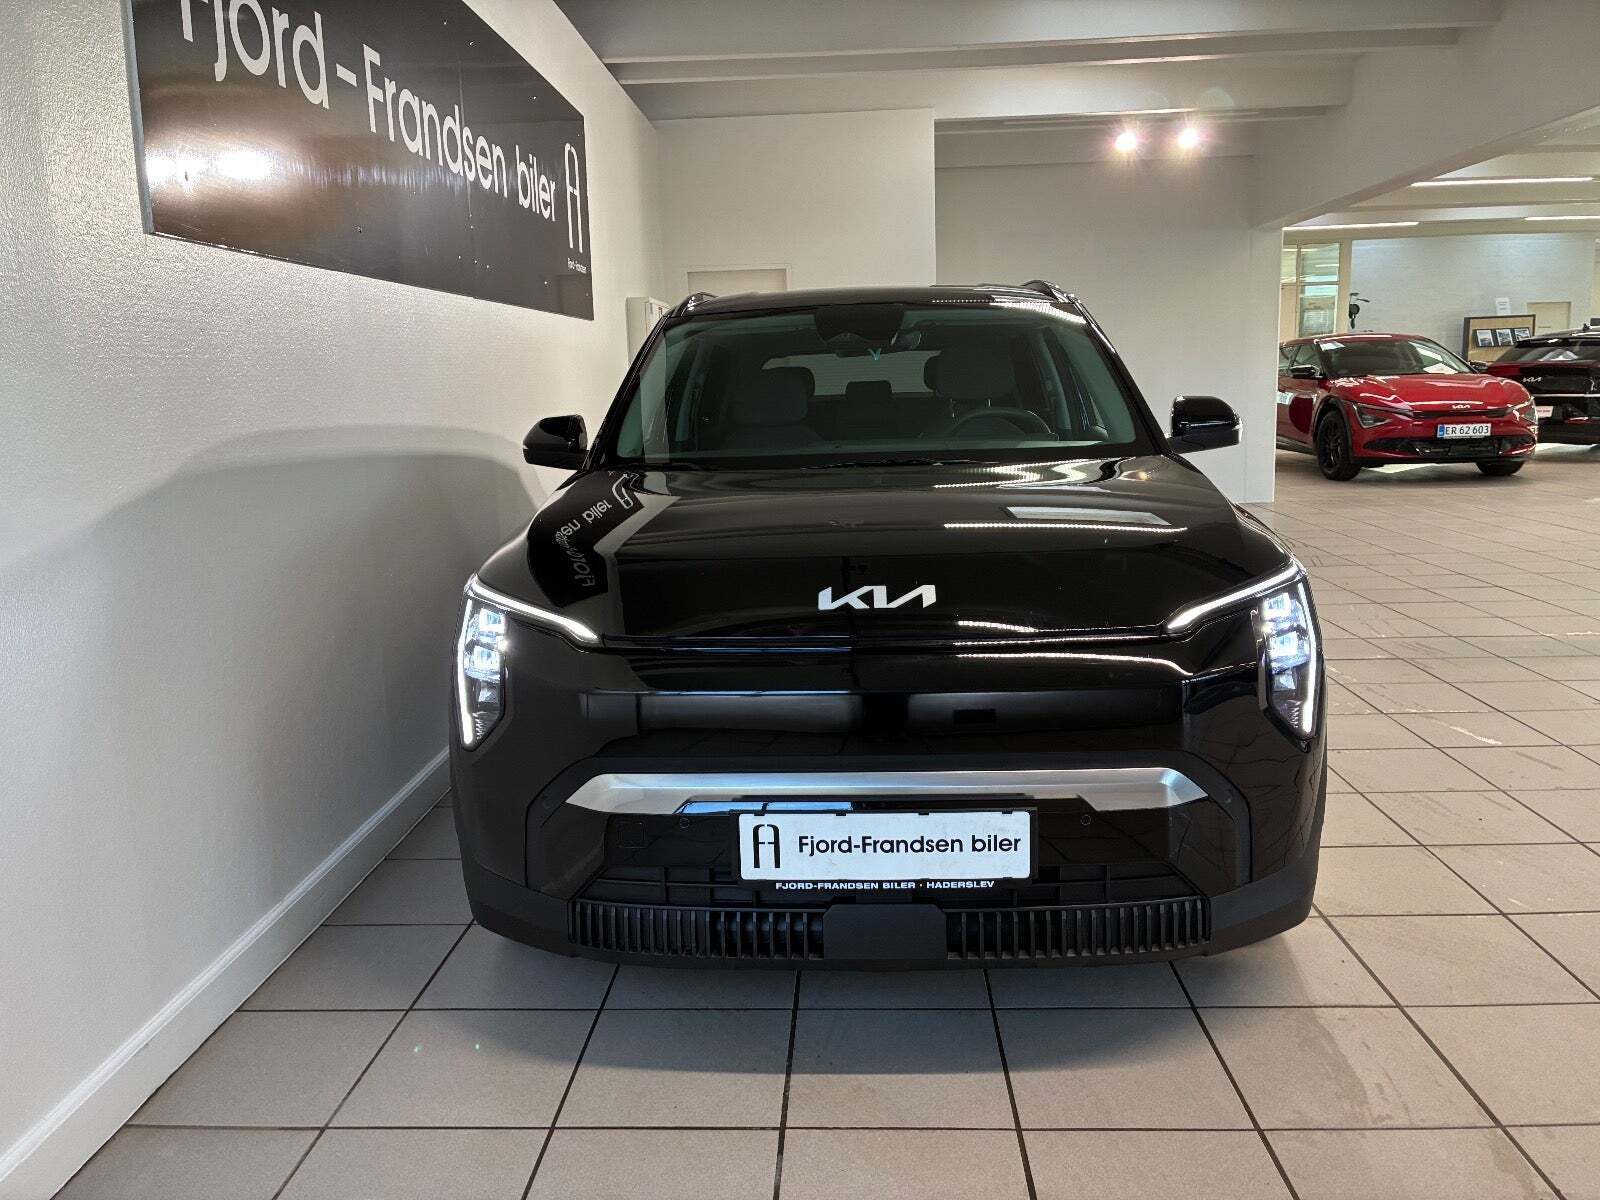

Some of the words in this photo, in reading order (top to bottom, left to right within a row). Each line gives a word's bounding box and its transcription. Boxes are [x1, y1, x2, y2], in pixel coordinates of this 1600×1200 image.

[515, 144, 556, 222] biler
[1445, 426, 1457, 435] ER
[1459, 425, 1471, 435] 62
[1472, 425, 1489, 434] 603
[818, 584, 937, 611] KIA
[798, 835, 964, 857] Fjord-Frandsen
[971, 834, 1022, 852] biler
[775, 882, 879, 890] FJORD-FRANDSEN
[882, 881, 916, 889] BILER
[926, 880, 995, 889] HADERSLEV
